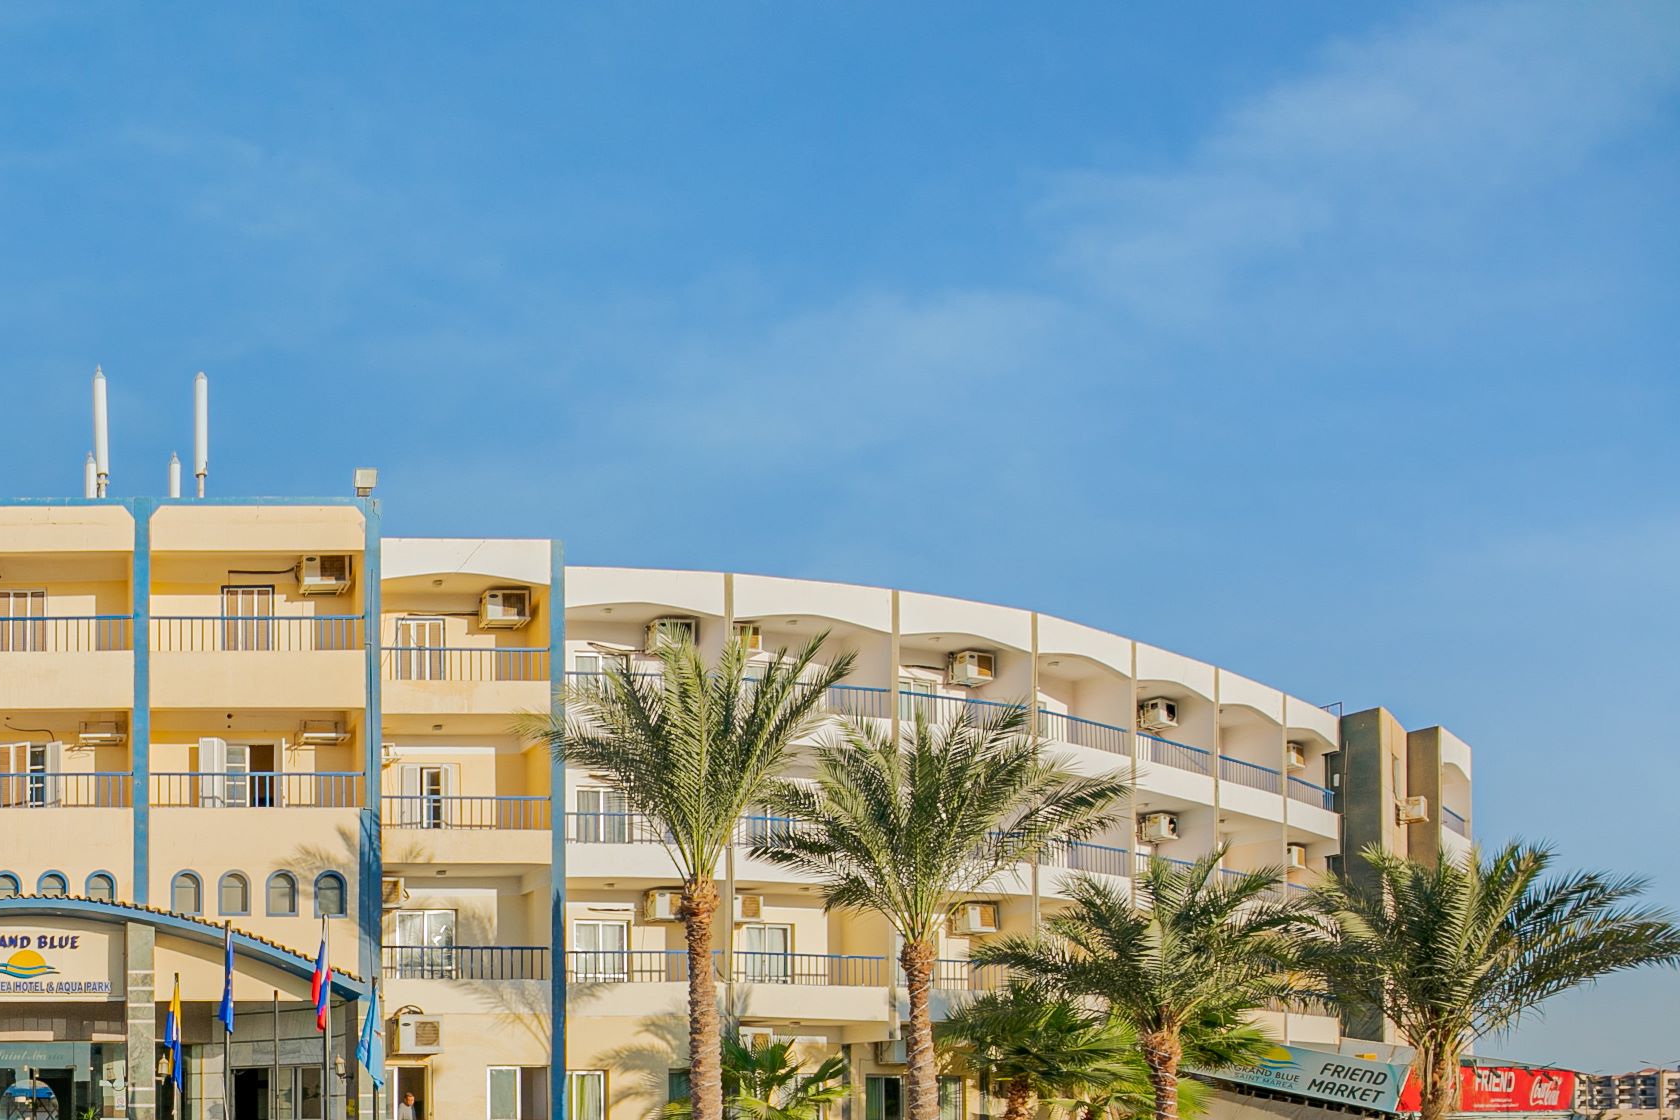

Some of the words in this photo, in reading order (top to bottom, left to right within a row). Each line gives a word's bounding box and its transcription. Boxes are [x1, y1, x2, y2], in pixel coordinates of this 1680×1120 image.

[37, 935, 80, 949] BLUE
[14, 981, 45, 992] HOTEL
[47, 981, 55, 992] &
[57, 981, 83, 993] AQUA
[84, 981, 112, 992] PARK
[1234, 1064, 1272, 1077] GRAND
[1275, 1072, 1301, 1083] BLUE
[1263, 1078, 1294, 1088] MAREA
[1320, 1063, 1387, 1085] FRIEND
[1476, 1070, 1515, 1092] FRIEND
[1307, 1079, 1385, 1103] MARKET
